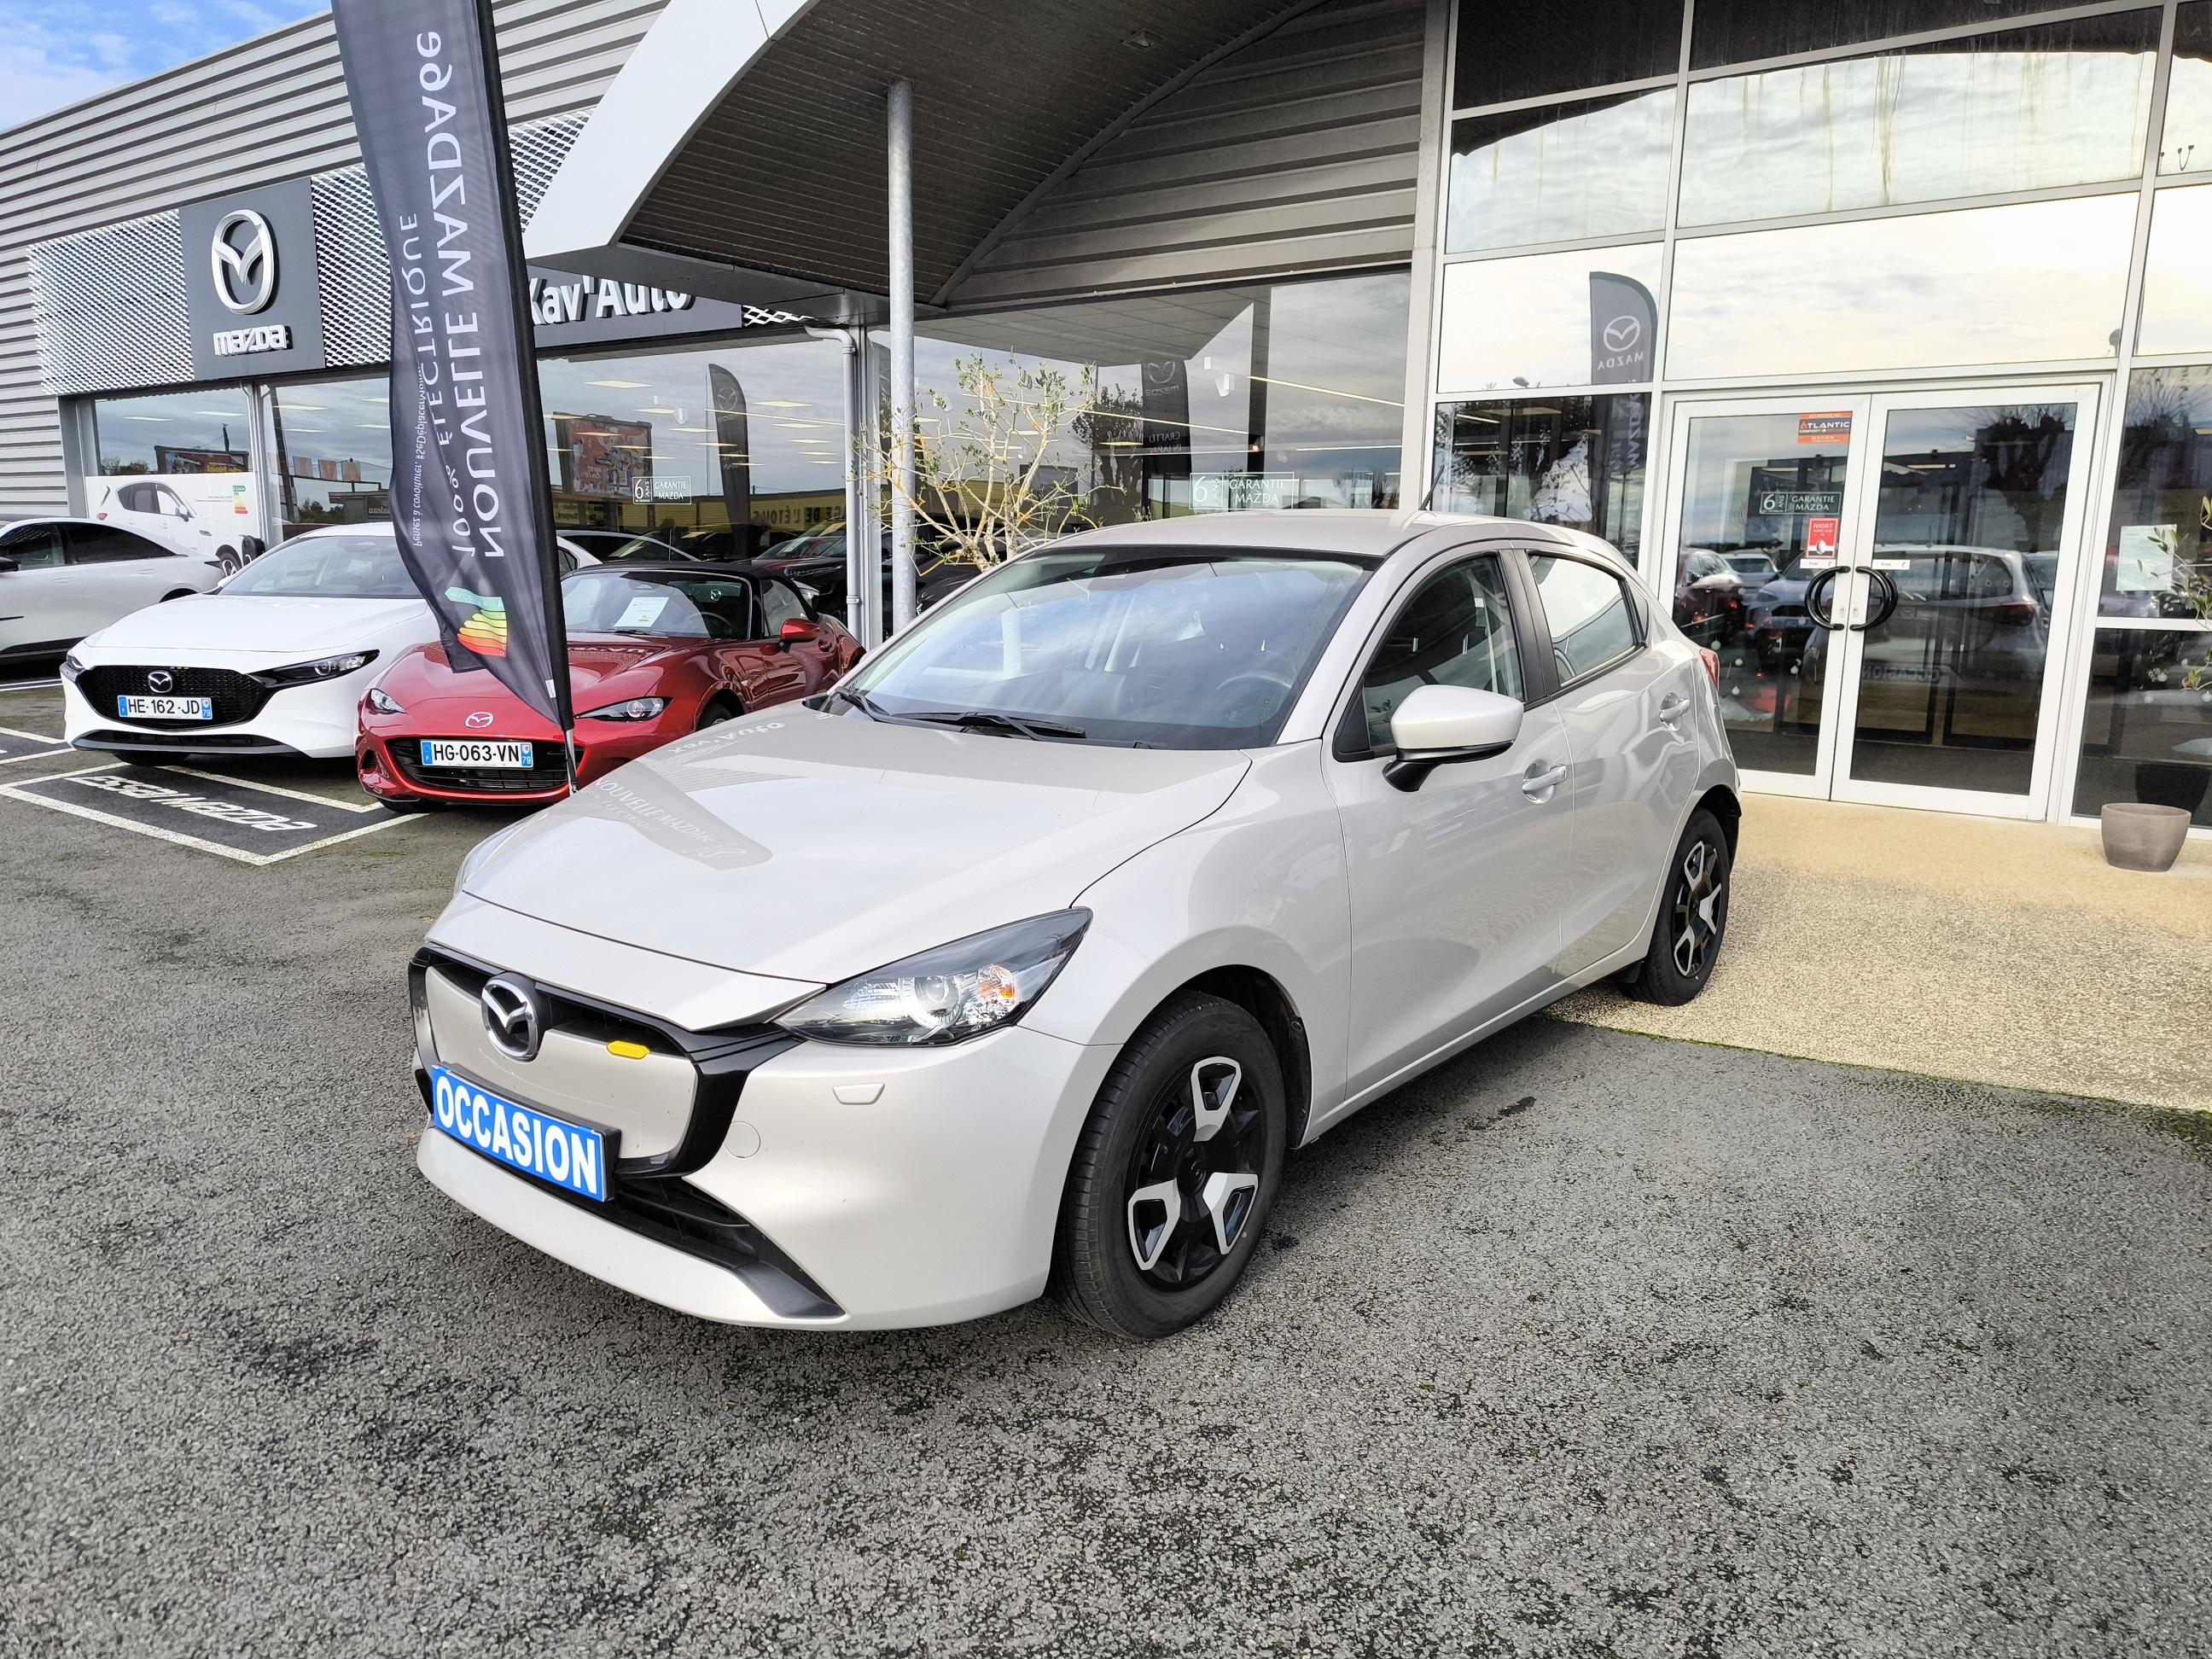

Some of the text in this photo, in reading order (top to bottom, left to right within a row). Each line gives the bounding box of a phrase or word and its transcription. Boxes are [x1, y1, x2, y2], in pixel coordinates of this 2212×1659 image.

[1800, 421, 1850, 429] ATLANTIC
[635, 479, 643, 499] 6
[655, 480, 687, 490] GARANTIE
[1194, 475, 1208, 503] 6
[1229, 479, 1284, 490] GARANTIE
[658, 492, 684, 500] MAZDA
[1235, 493, 1279, 504] MAZDA
[1791, 495, 1836, 504] GARANTIE
[1763, 494, 1776, 510] 6
[128, 698, 200, 714] HE-162-JD
[434, 744, 519, 761] HG-063-VN
[522, 755, 531, 764] 79
[436, 1075, 597, 1195] OCCASION
